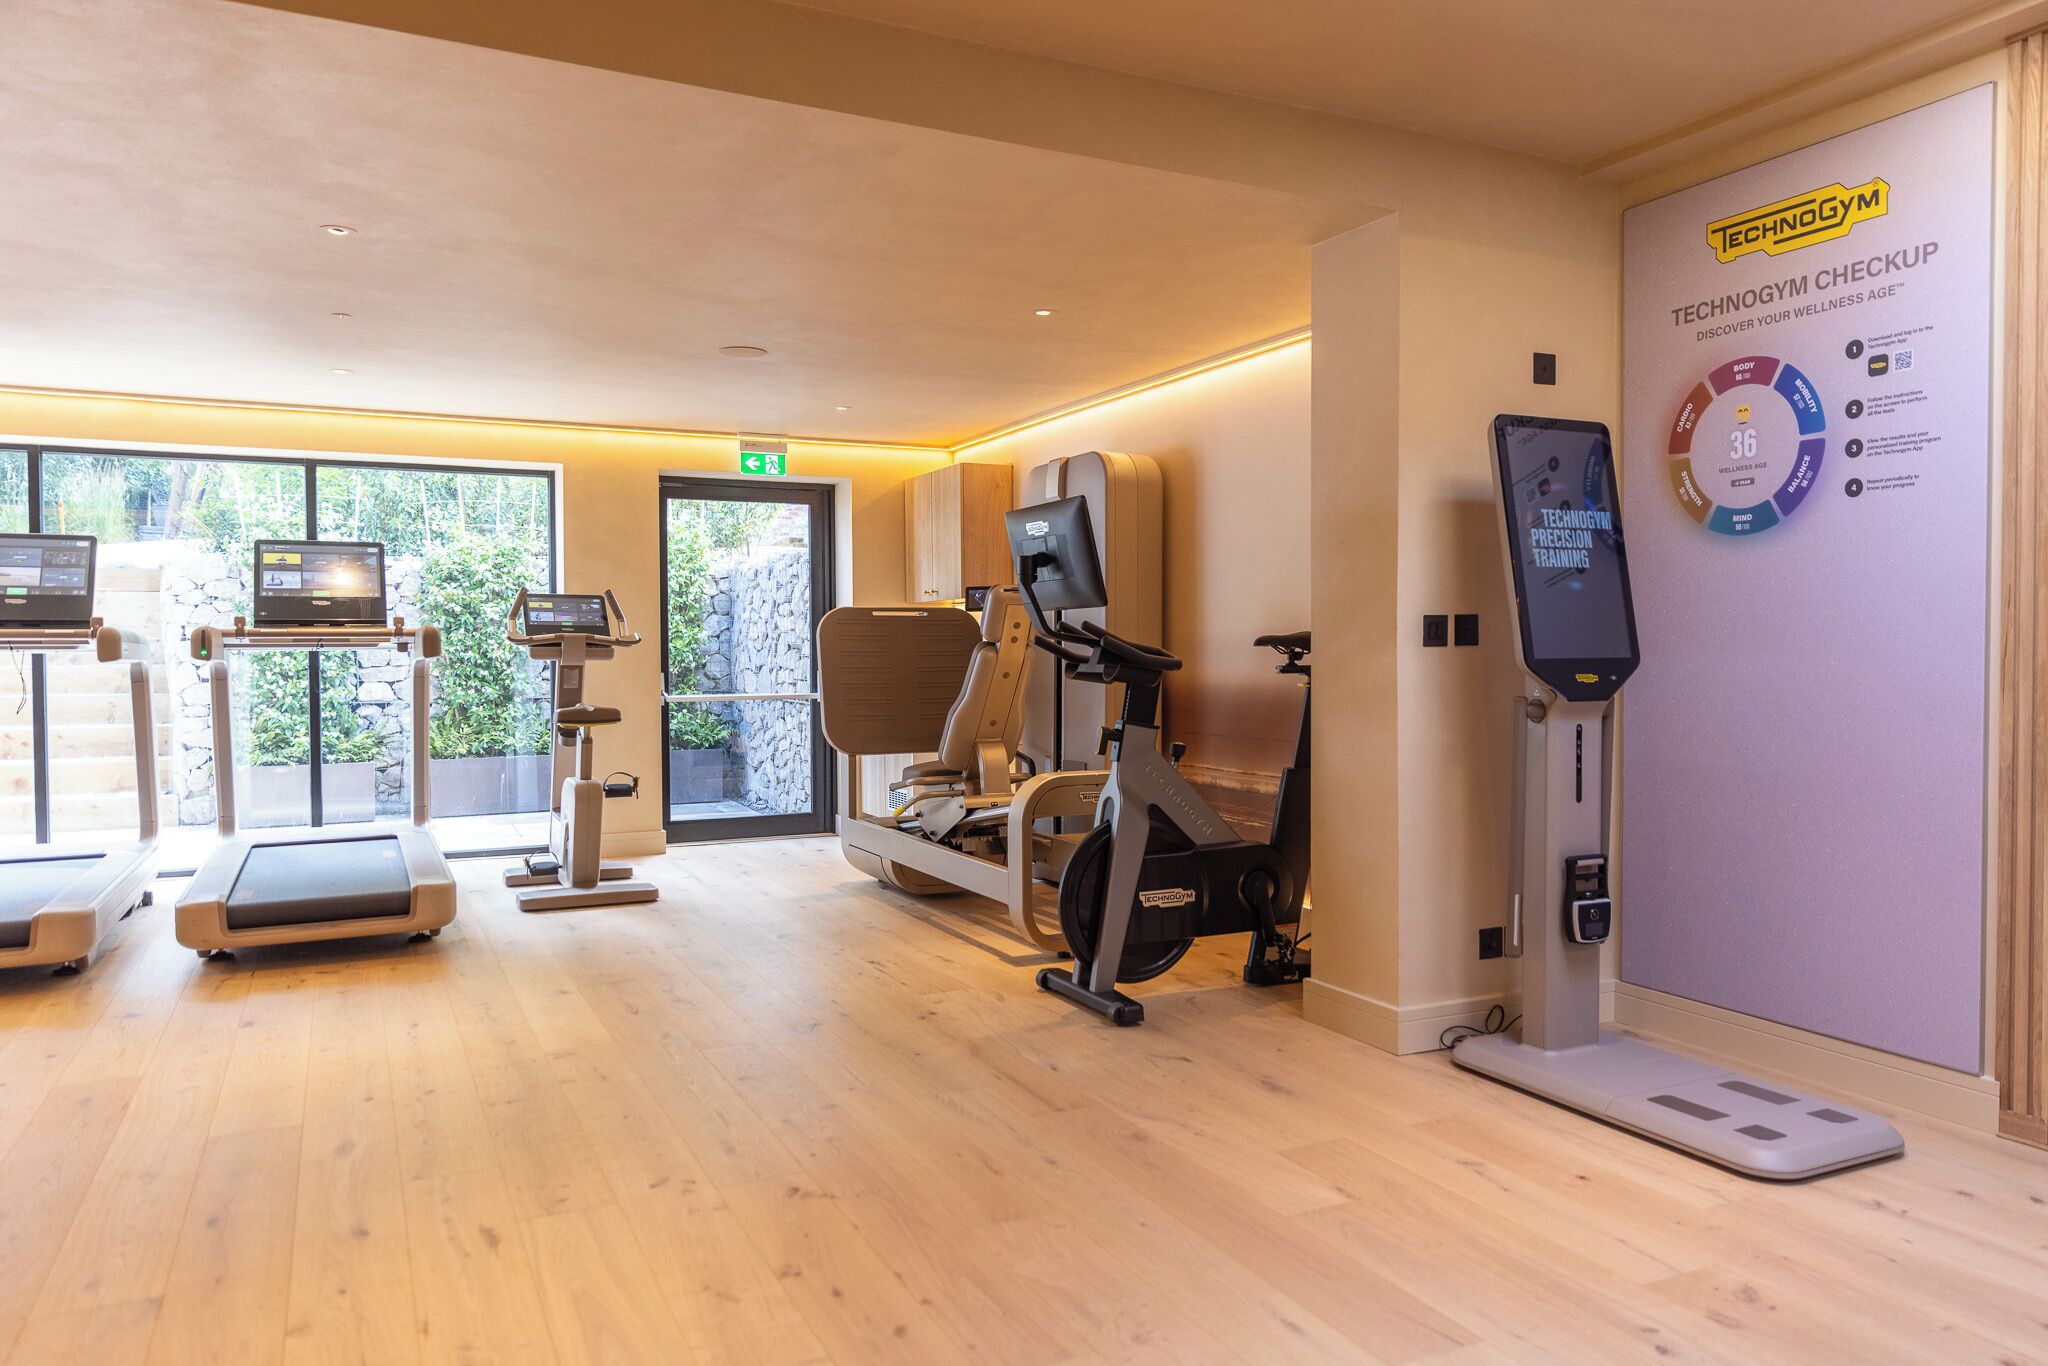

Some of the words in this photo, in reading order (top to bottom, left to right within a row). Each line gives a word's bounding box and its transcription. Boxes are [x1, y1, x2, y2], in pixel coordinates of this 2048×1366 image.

[1711, 189, 1880, 254] TECHNOGYM
[1671, 274, 1808, 327] TECHNOGYM
[1814, 241, 1939, 290] CHECKUP
[1696, 319, 1754, 341] DISCOVER
[1757, 310, 1791, 327] YOUR
[1793, 292, 1864, 318] WELLNESS
[1733, 361, 1755, 373] BODY
[1794, 378, 1818, 412] MOBILITY
[1676, 402, 1693, 432] CARDIO
[1729, 428, 1758, 460] 36
[1718, 463, 1753, 474] WELLNESS
[1754, 461, 1768, 469] AGE
[1787, 454, 1811, 493] BALANCE
[1681, 470, 1703, 507] STRENGTH
[1541, 508, 1612, 530] TECHNOGYM
[1732, 513, 1753, 522] MIND
[1530, 527, 1593, 549] PRECISION
[1532, 548, 1590, 568] TRAINING
[1140, 890, 1194, 905] TECHNOGYM
